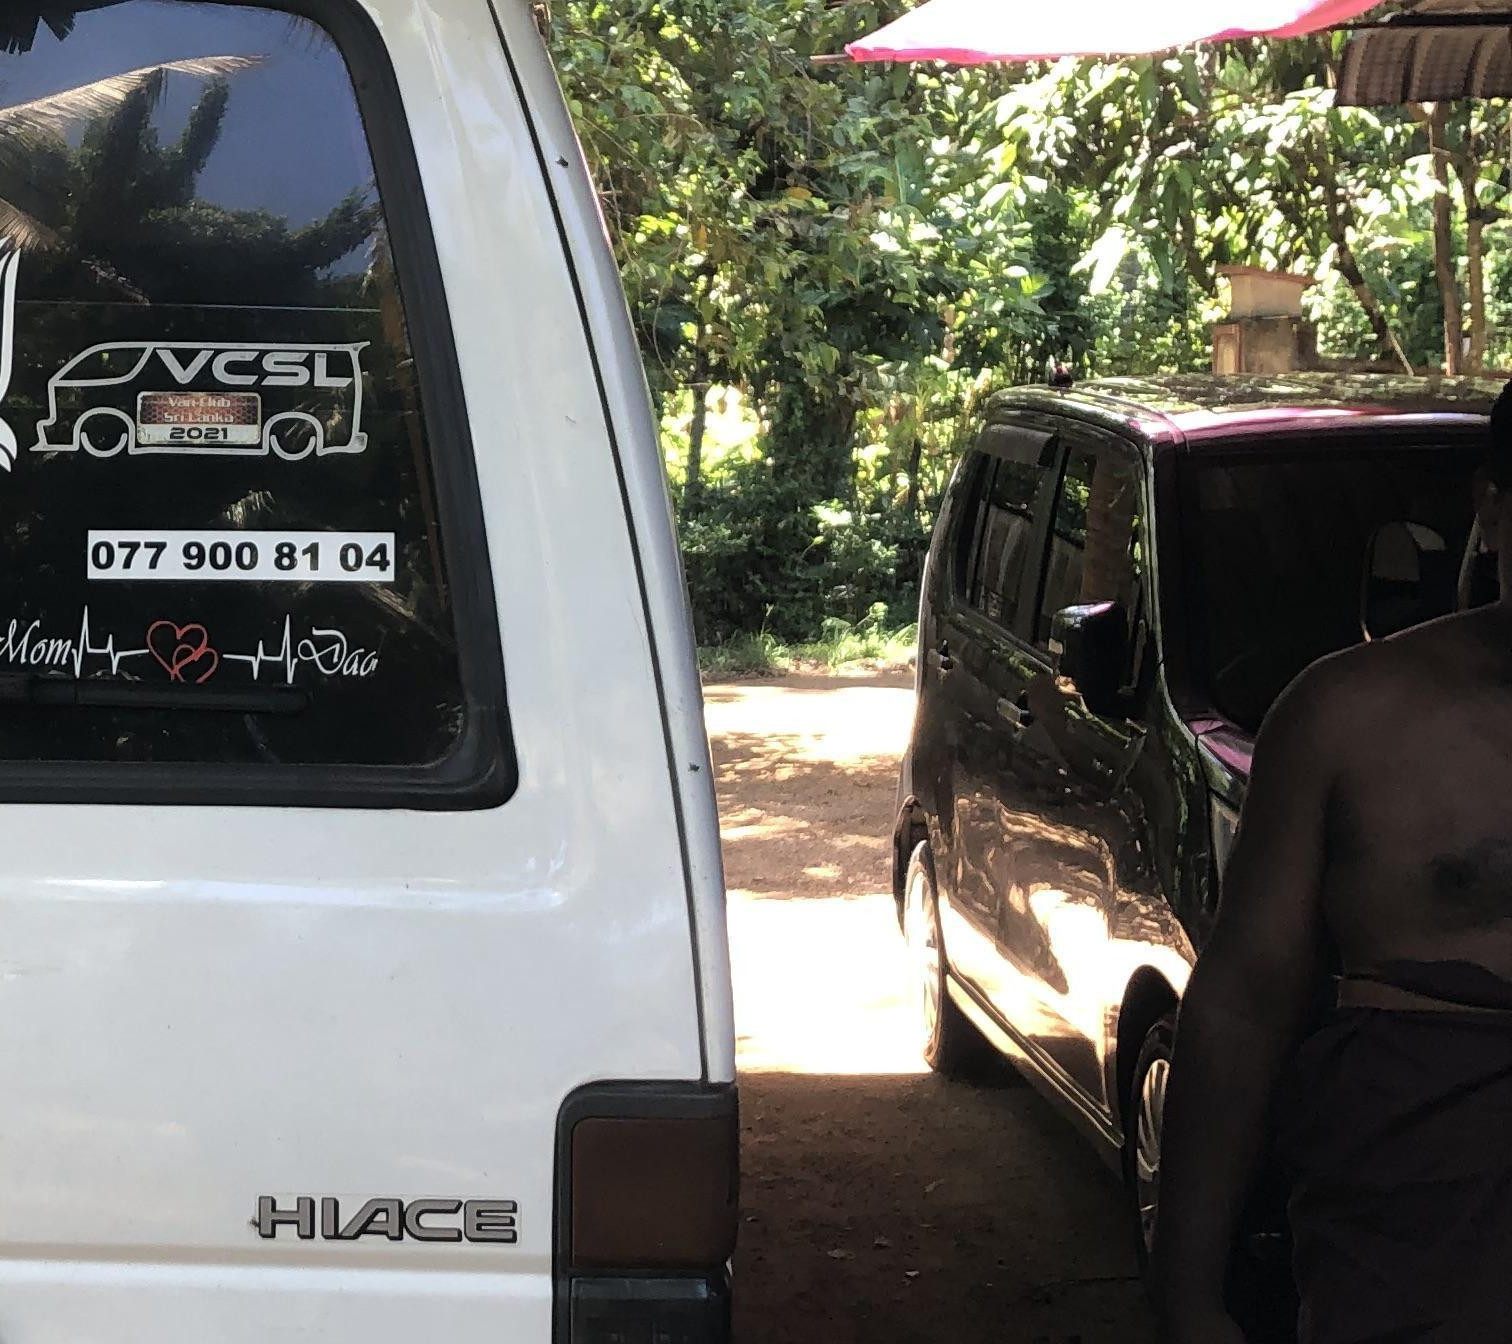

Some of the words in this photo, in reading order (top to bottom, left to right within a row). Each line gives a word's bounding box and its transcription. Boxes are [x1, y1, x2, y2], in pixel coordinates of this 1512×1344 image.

[156, 349, 353, 388] VCSL
[164, 412, 185, 423] Sri
[169, 427, 228, 440] 2021
[92, 541, 167, 571] 077
[182, 541, 258, 571] 900
[274, 541, 320, 572] 81
[339, 542, 391, 573] 04
[258, 1195, 518, 1244] HIACE
